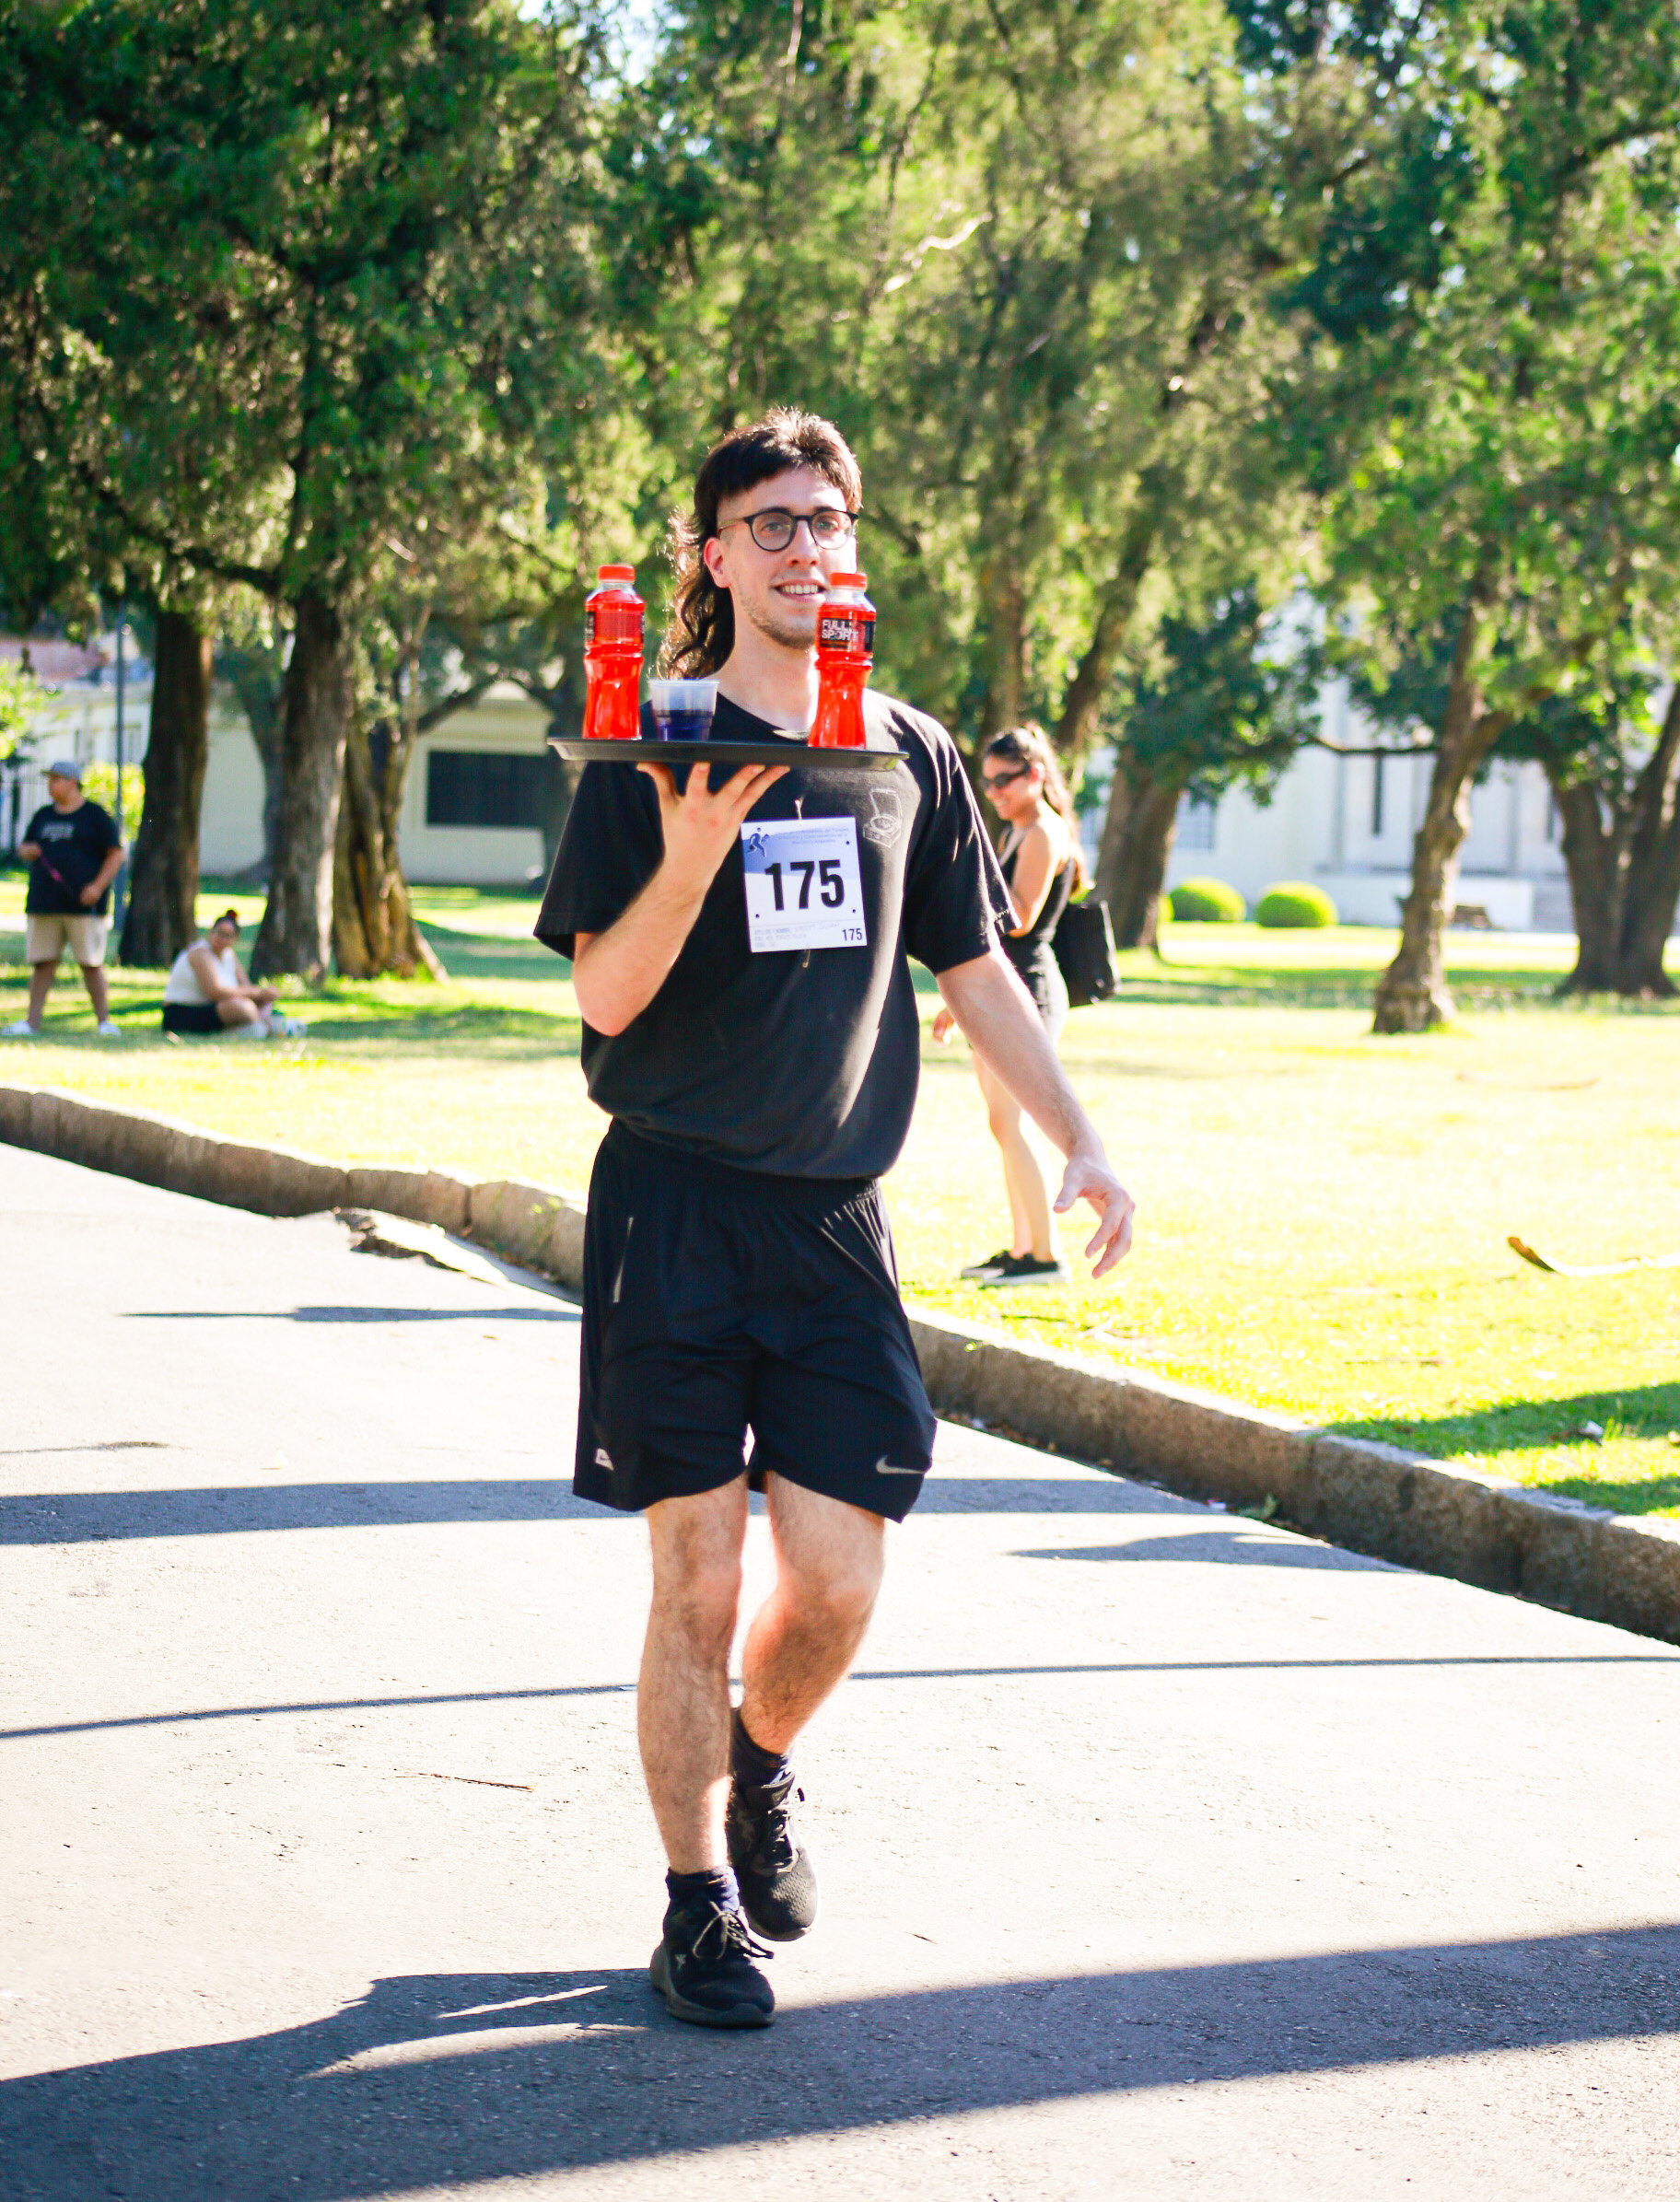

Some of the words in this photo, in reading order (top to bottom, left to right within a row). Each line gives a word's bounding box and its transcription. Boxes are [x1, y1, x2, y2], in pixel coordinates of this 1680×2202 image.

[822, 629, 858, 642] SPORT
[764, 859, 845, 911] 175
[842, 927, 863, 941] 175
